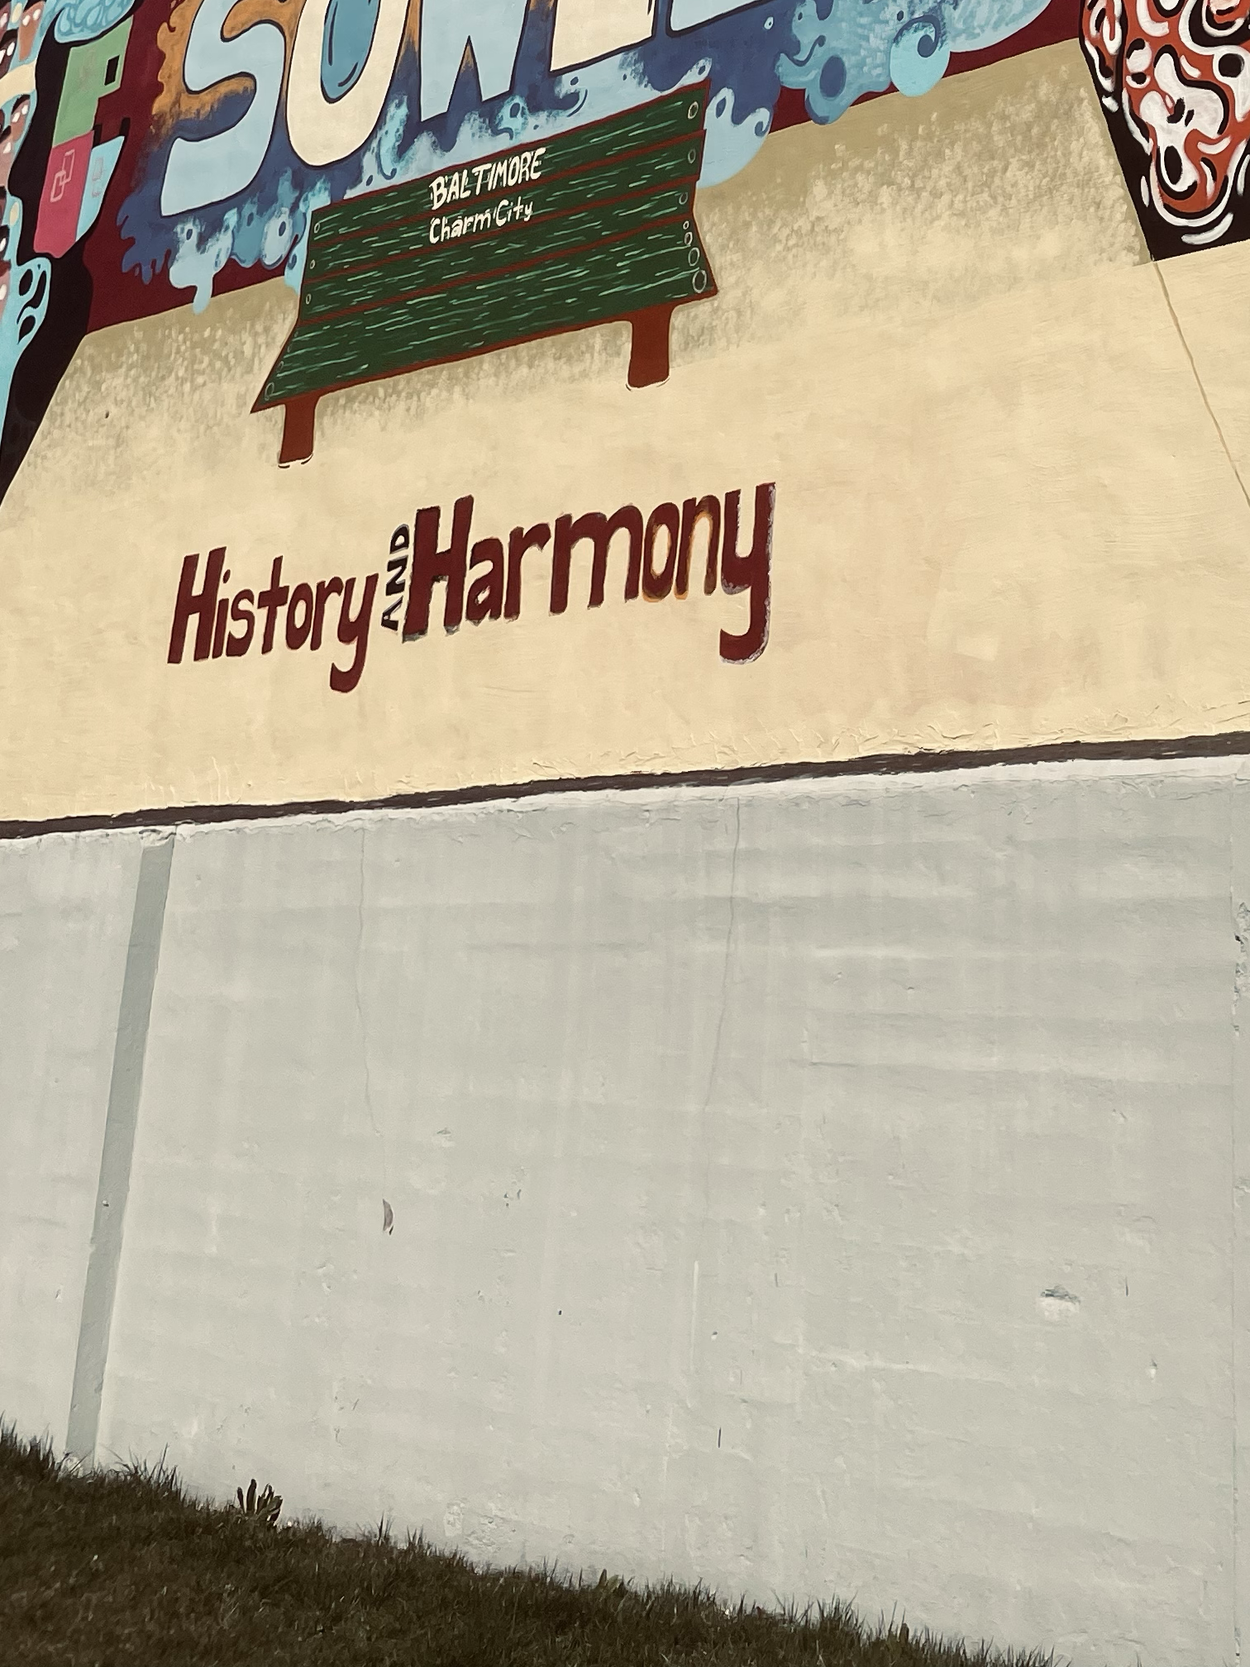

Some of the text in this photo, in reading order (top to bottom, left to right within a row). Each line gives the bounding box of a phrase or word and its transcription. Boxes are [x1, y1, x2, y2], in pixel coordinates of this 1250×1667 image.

[429, 147, 546, 210] BALTIMORE
[429, 196, 534, 244] Charm City
[167, 482, 776, 693] History AND Harmony
